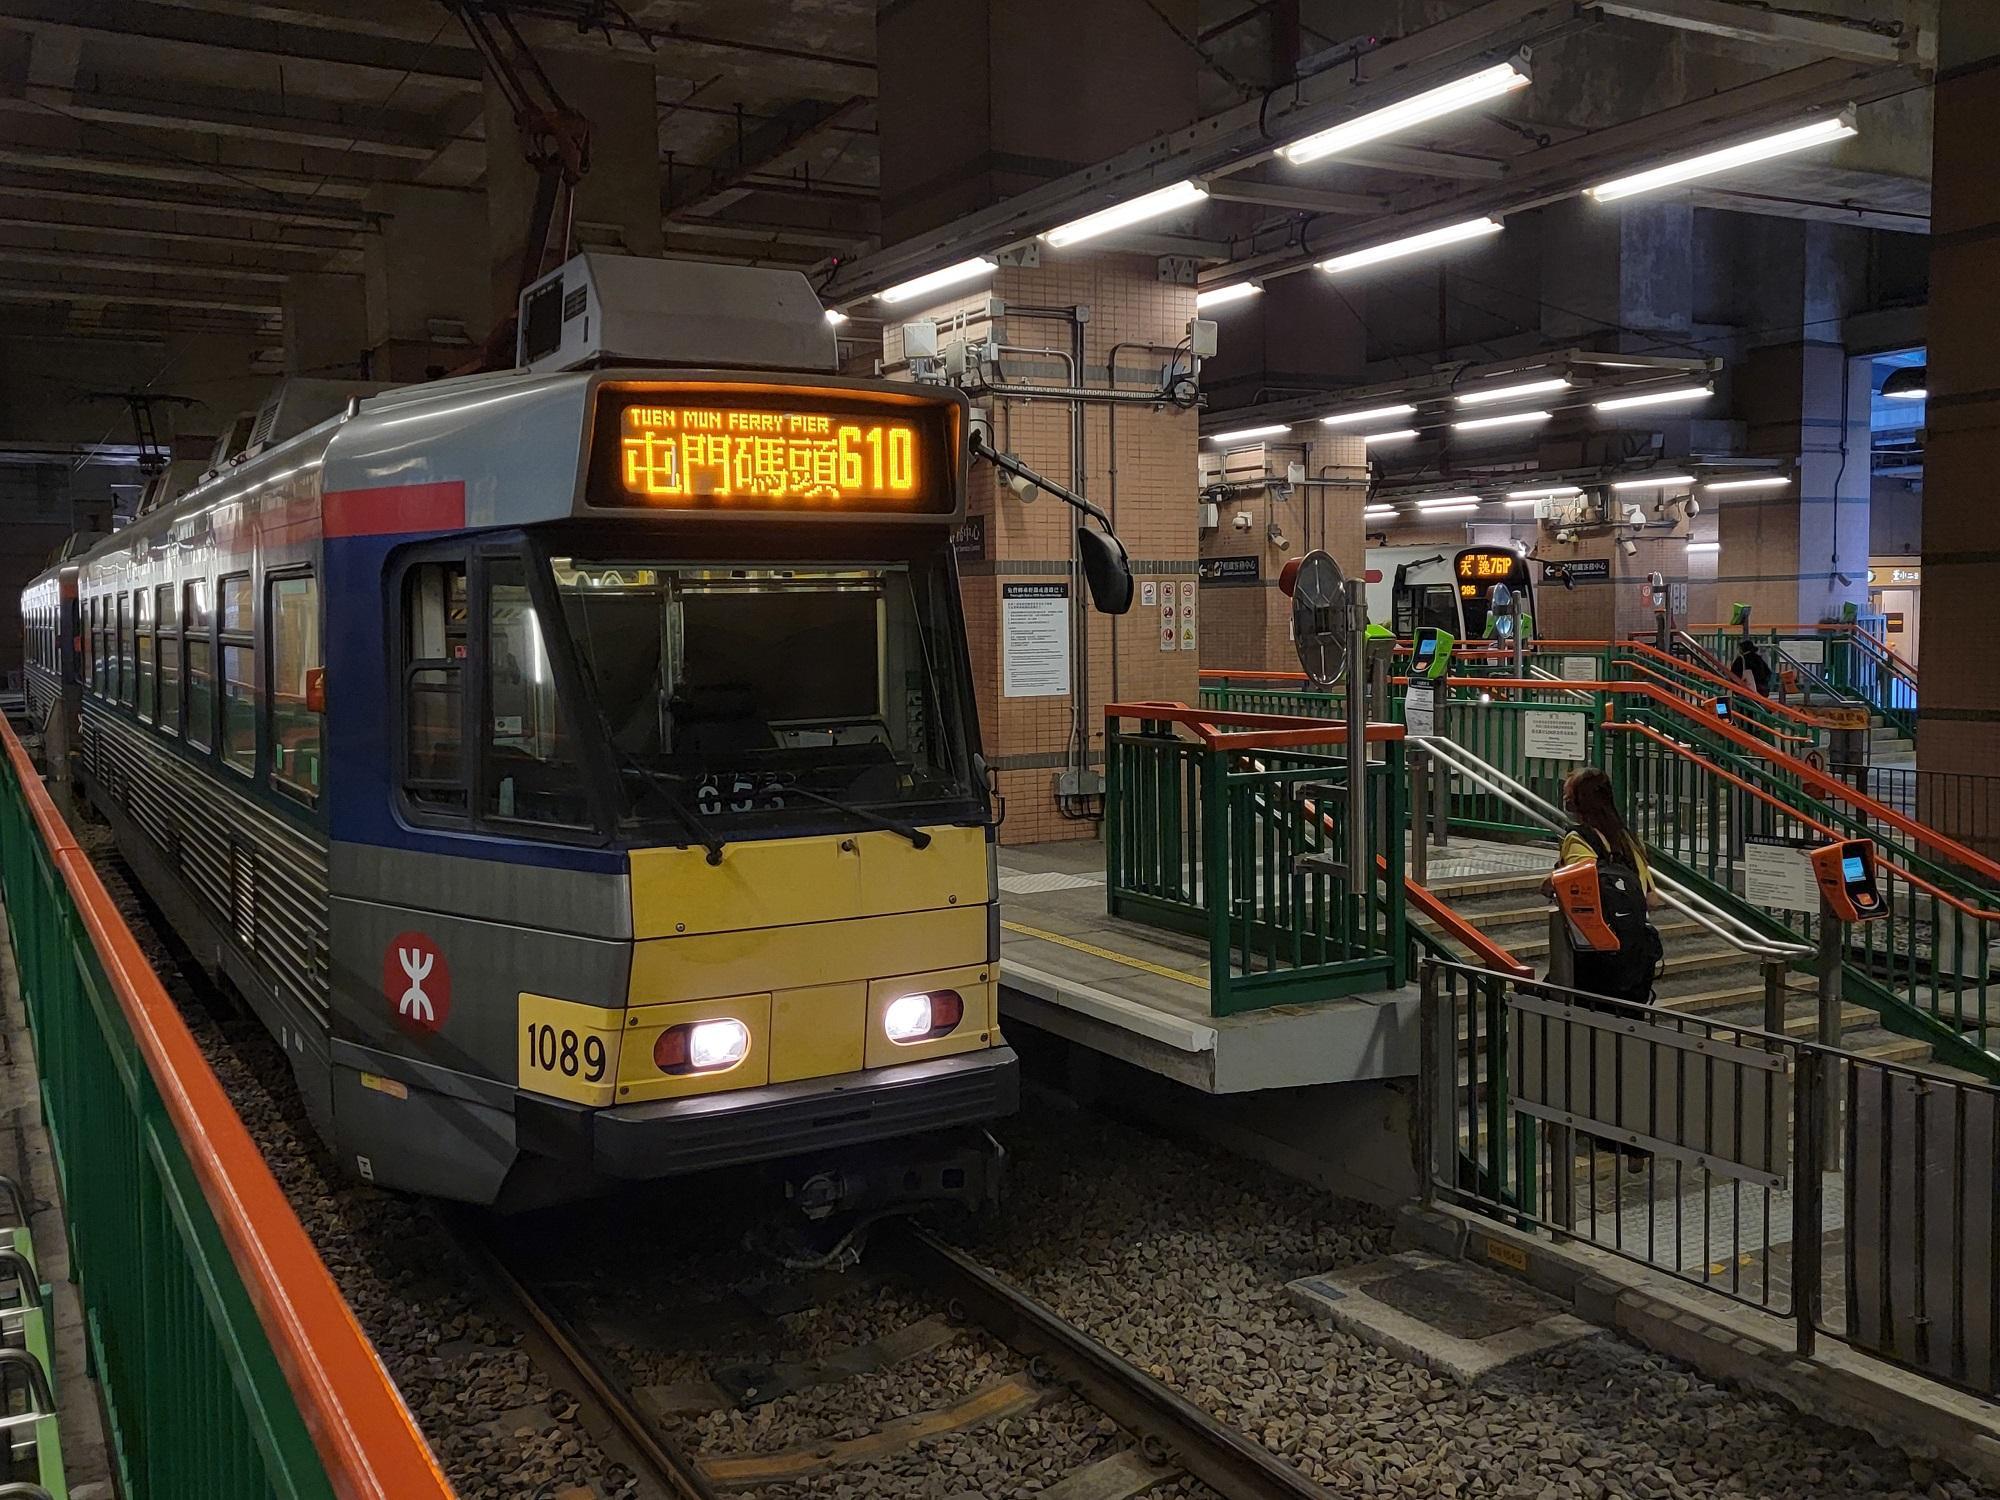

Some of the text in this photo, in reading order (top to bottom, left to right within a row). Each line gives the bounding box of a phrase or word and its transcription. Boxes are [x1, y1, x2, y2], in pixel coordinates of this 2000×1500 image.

[631, 408, 830, 434] TUEN MUN FERRY PIER
[624, 426, 912, 498] 屯門碼頭 610
[1490, 557, 1512, 574] 761P
[528, 1022, 606, 1082] 1089
